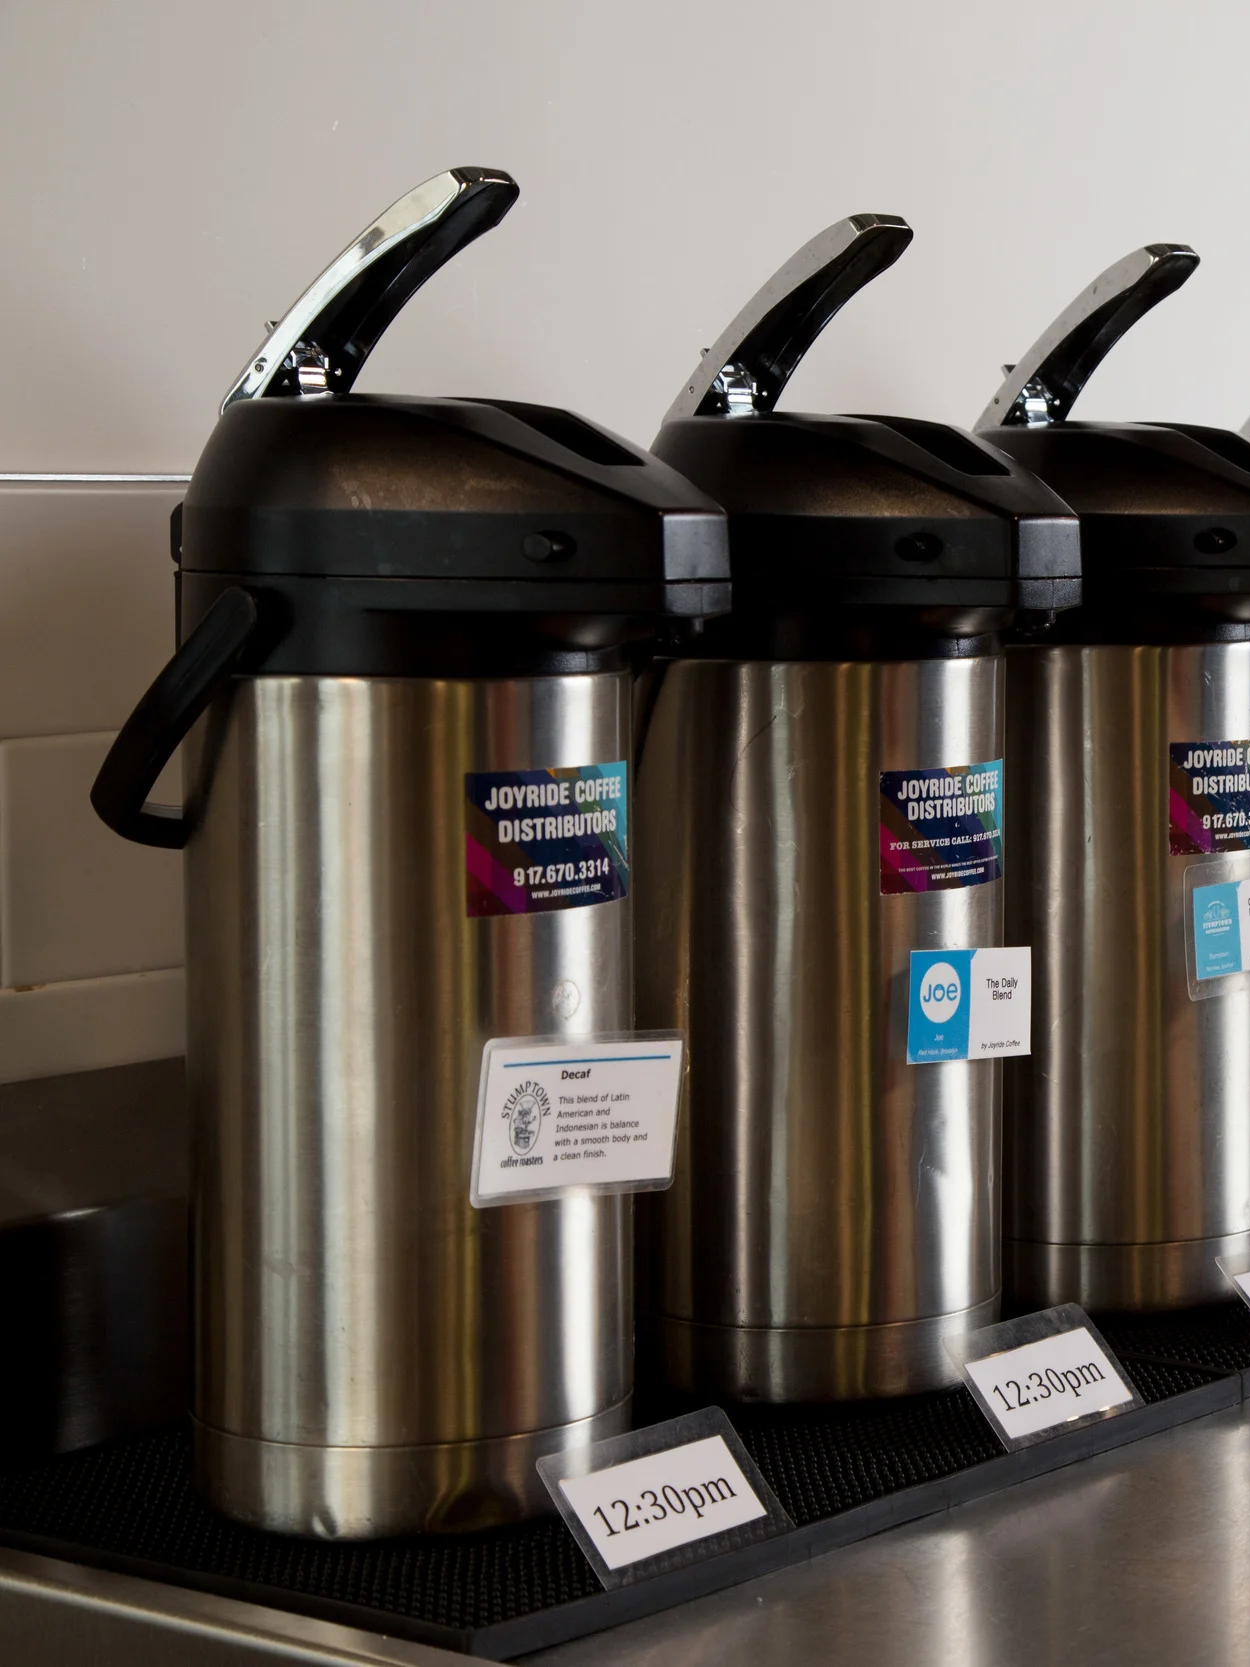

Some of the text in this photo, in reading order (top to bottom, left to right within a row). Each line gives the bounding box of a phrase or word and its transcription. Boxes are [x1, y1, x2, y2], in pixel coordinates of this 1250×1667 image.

[1184, 748, 1243, 769] JOYRIDE
[897, 771, 998, 800] JOYRIDE COFFEE
[485, 776, 621, 811] JOYRIDE COFFEE
[908, 792, 995, 821] DISTRIBUTORS
[498, 809, 616, 843] DISTRIBUTORS
[890, 842, 910, 851] FOR
[912, 838, 950, 849] SERVICE
[952, 835, 972, 845] CALL:
[513, 858, 609, 886] 917.670.3314
[986, 977, 1018, 989] The Daily
[992, 990, 1012, 1000] Blend
[981, 1040, 1021, 1050] by Joyride Coffee
[561, 1069, 591, 1081] Decaf
[501, 1081, 551, 1120] STUMPTOWN
[559, 1093, 630, 1105] This blend of Latin
[557, 1107, 611, 1119] American and
[556, 1120, 640, 1133] Indonesian is balance
[554, 1137, 571, 1147] with
[580, 1135, 610, 1145] smooth
[612, 1133, 631, 1145] body
[633, 1132, 648, 1142] and
[500, 1155, 543, 1169] coffee roasters
[561, 1151, 581, 1161] clean
[583, 1149, 607, 1159] finish.
[993, 1361, 1106, 1412] 12:30pm
[593, 1476, 737, 1537] 12:30pm
